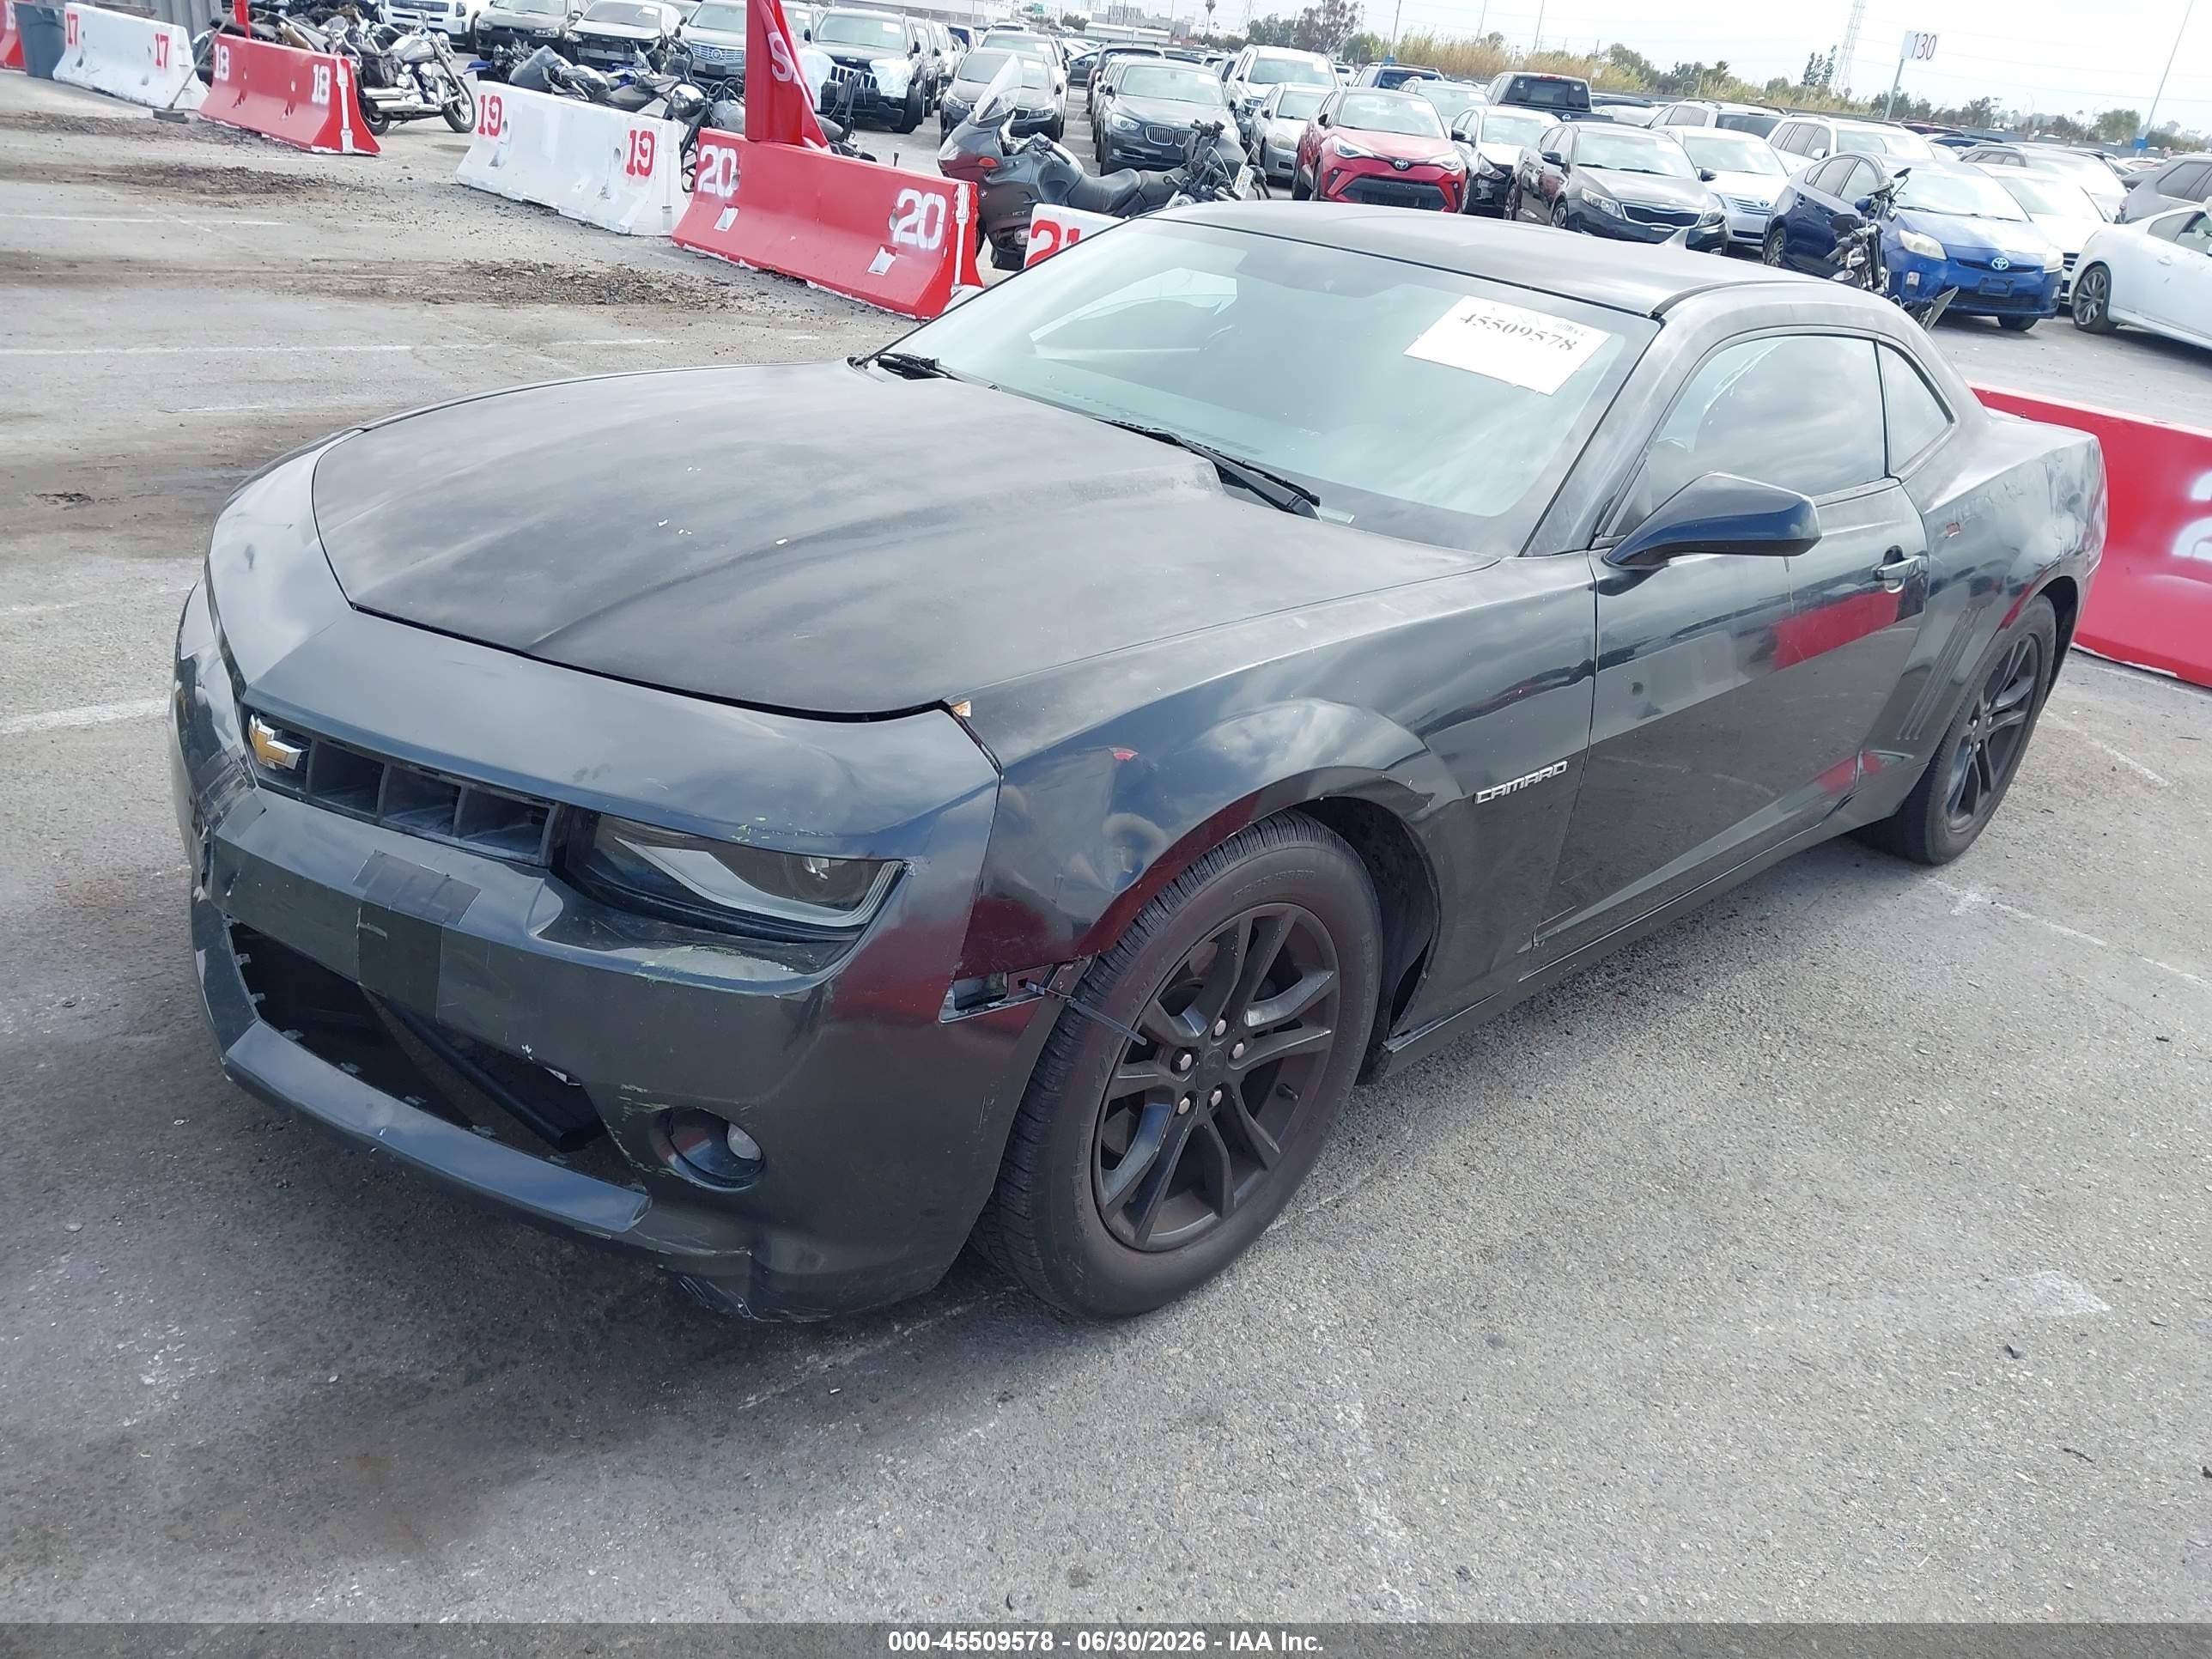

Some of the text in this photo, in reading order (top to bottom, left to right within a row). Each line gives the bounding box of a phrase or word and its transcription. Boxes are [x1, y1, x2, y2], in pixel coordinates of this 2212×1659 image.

[67, 13, 78, 46] 17
[1911, 33, 1937, 60] 130
[155, 33, 169, 69] 17
[215, 43, 230, 82] 18
[312, 64, 331, 104] 18
[477, 94, 503, 137] 19
[626, 130, 656, 177] 19
[697, 144, 738, 198] 20
[893, 188, 946, 250] 20
[1460, 313, 1578, 351] 45509578
[1477, 760, 1569, 805] CAMARO
